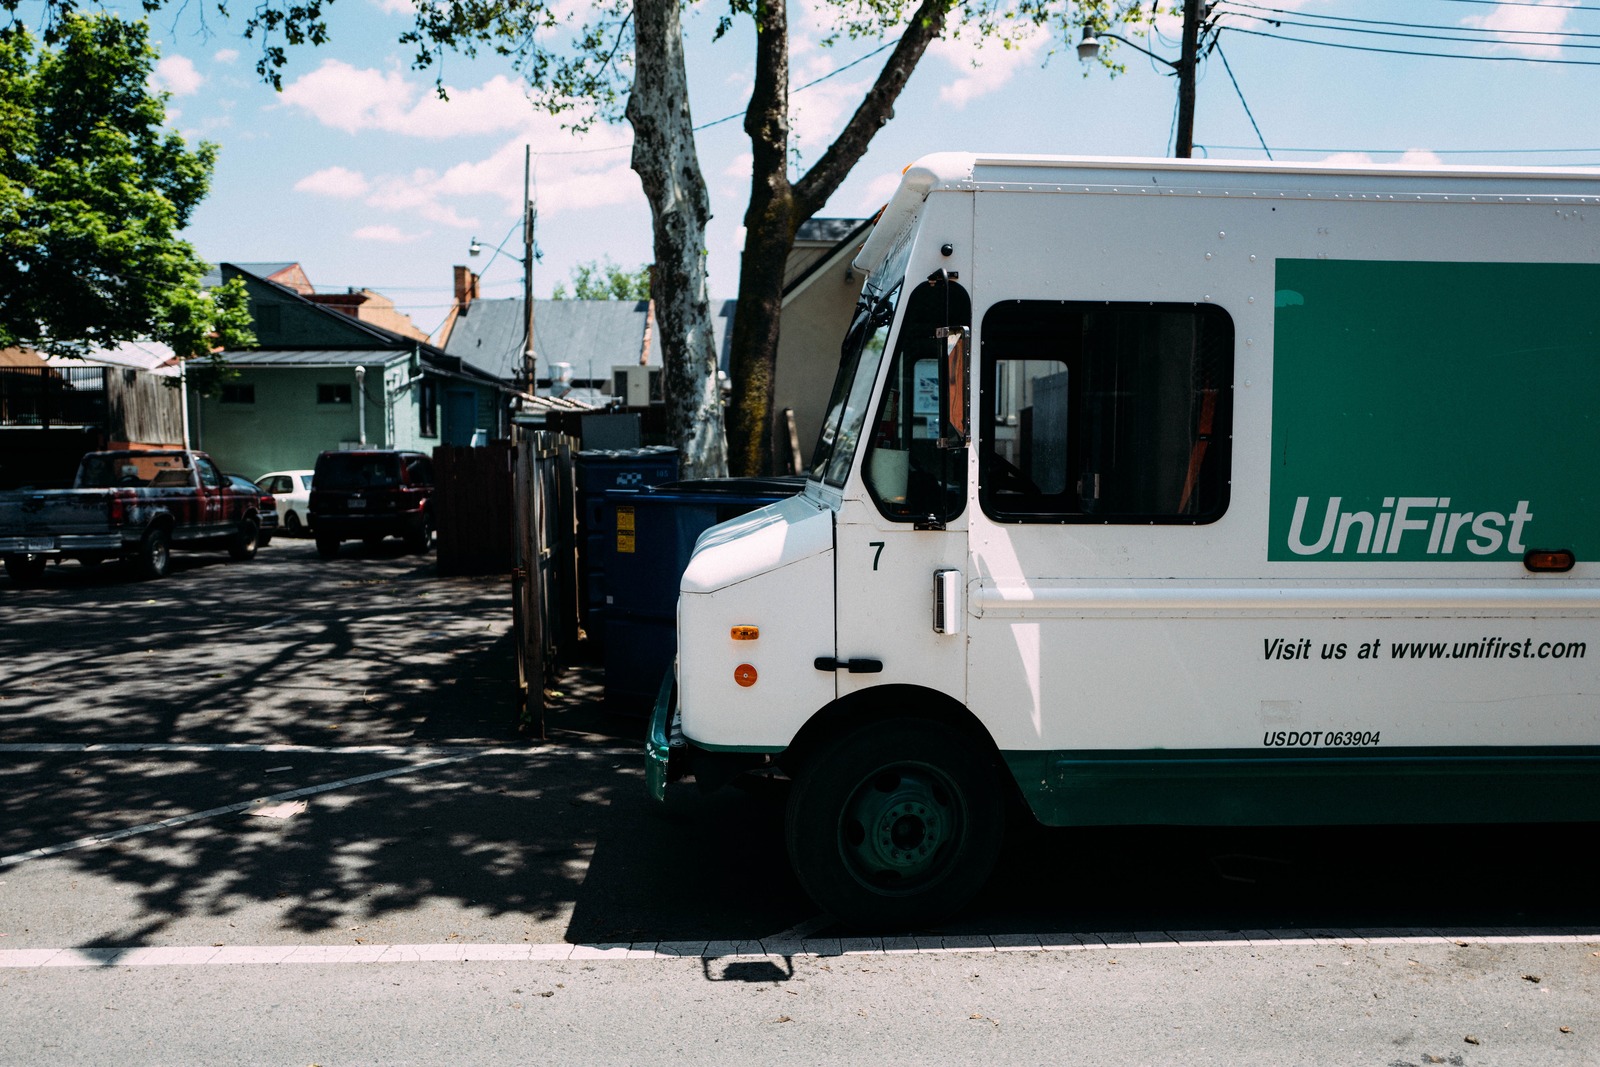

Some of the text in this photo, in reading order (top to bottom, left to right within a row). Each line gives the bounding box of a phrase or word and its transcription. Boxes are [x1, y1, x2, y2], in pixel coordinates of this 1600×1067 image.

[1287, 496, 1533, 555] UniFirst
[869, 541, 885, 571] 7
[1263, 637, 1587, 660] Visit us at www.unifirst.com
[1263, 731, 1380, 747] USDOT 063904
